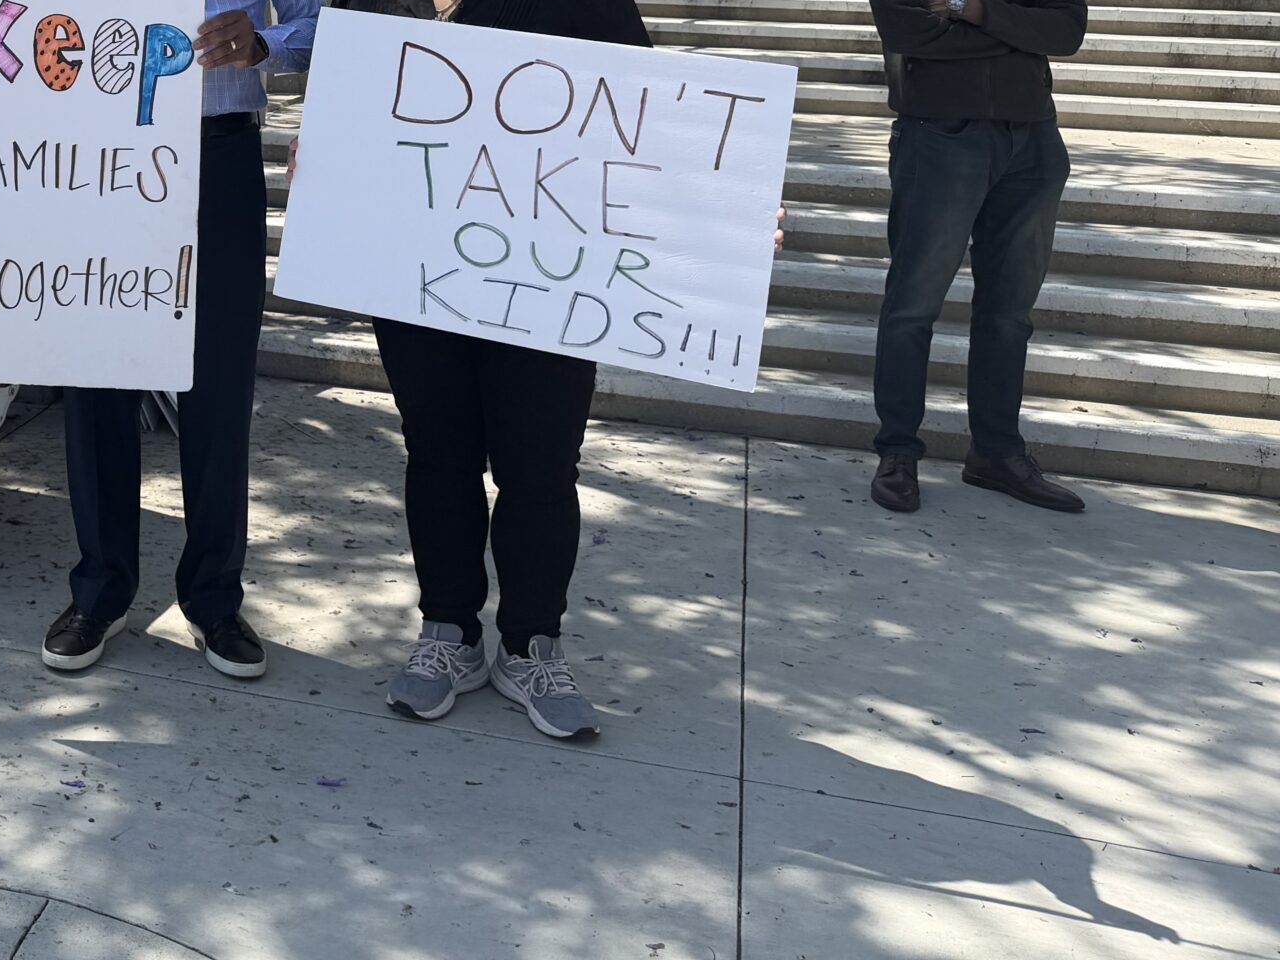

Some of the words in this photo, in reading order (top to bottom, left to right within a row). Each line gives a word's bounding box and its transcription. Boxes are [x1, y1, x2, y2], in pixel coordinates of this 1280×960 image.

[391, 41, 766, 171] DON'T
[396, 141, 663, 241] TAKE
[453, 221, 684, 309] OUR
[419, 262, 744, 384] KIDS!!!
